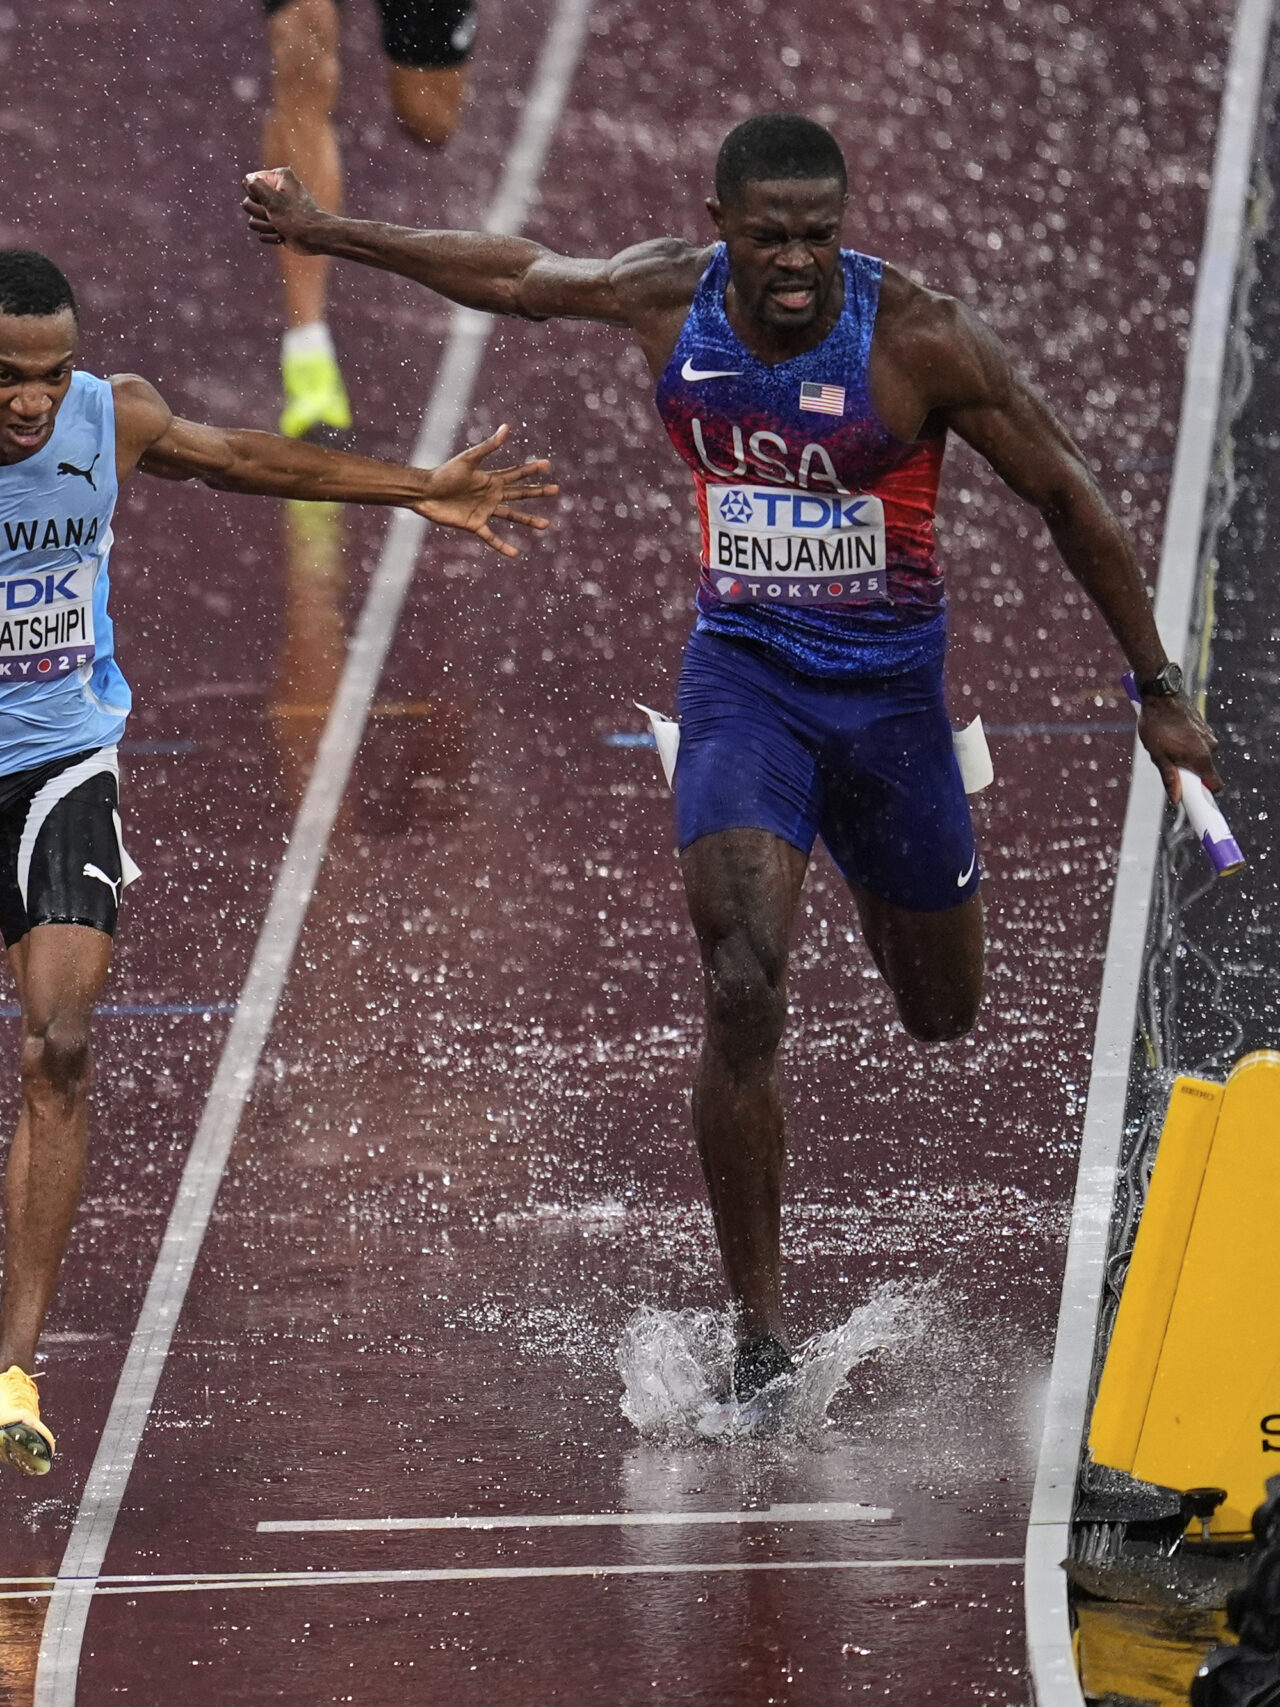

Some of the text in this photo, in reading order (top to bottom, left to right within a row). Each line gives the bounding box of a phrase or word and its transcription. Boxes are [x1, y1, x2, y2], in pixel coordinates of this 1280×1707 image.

[691, 417, 851, 495] USA
[753, 491, 869, 529] TDK
[718, 530, 877, 572] BENJAMIN
